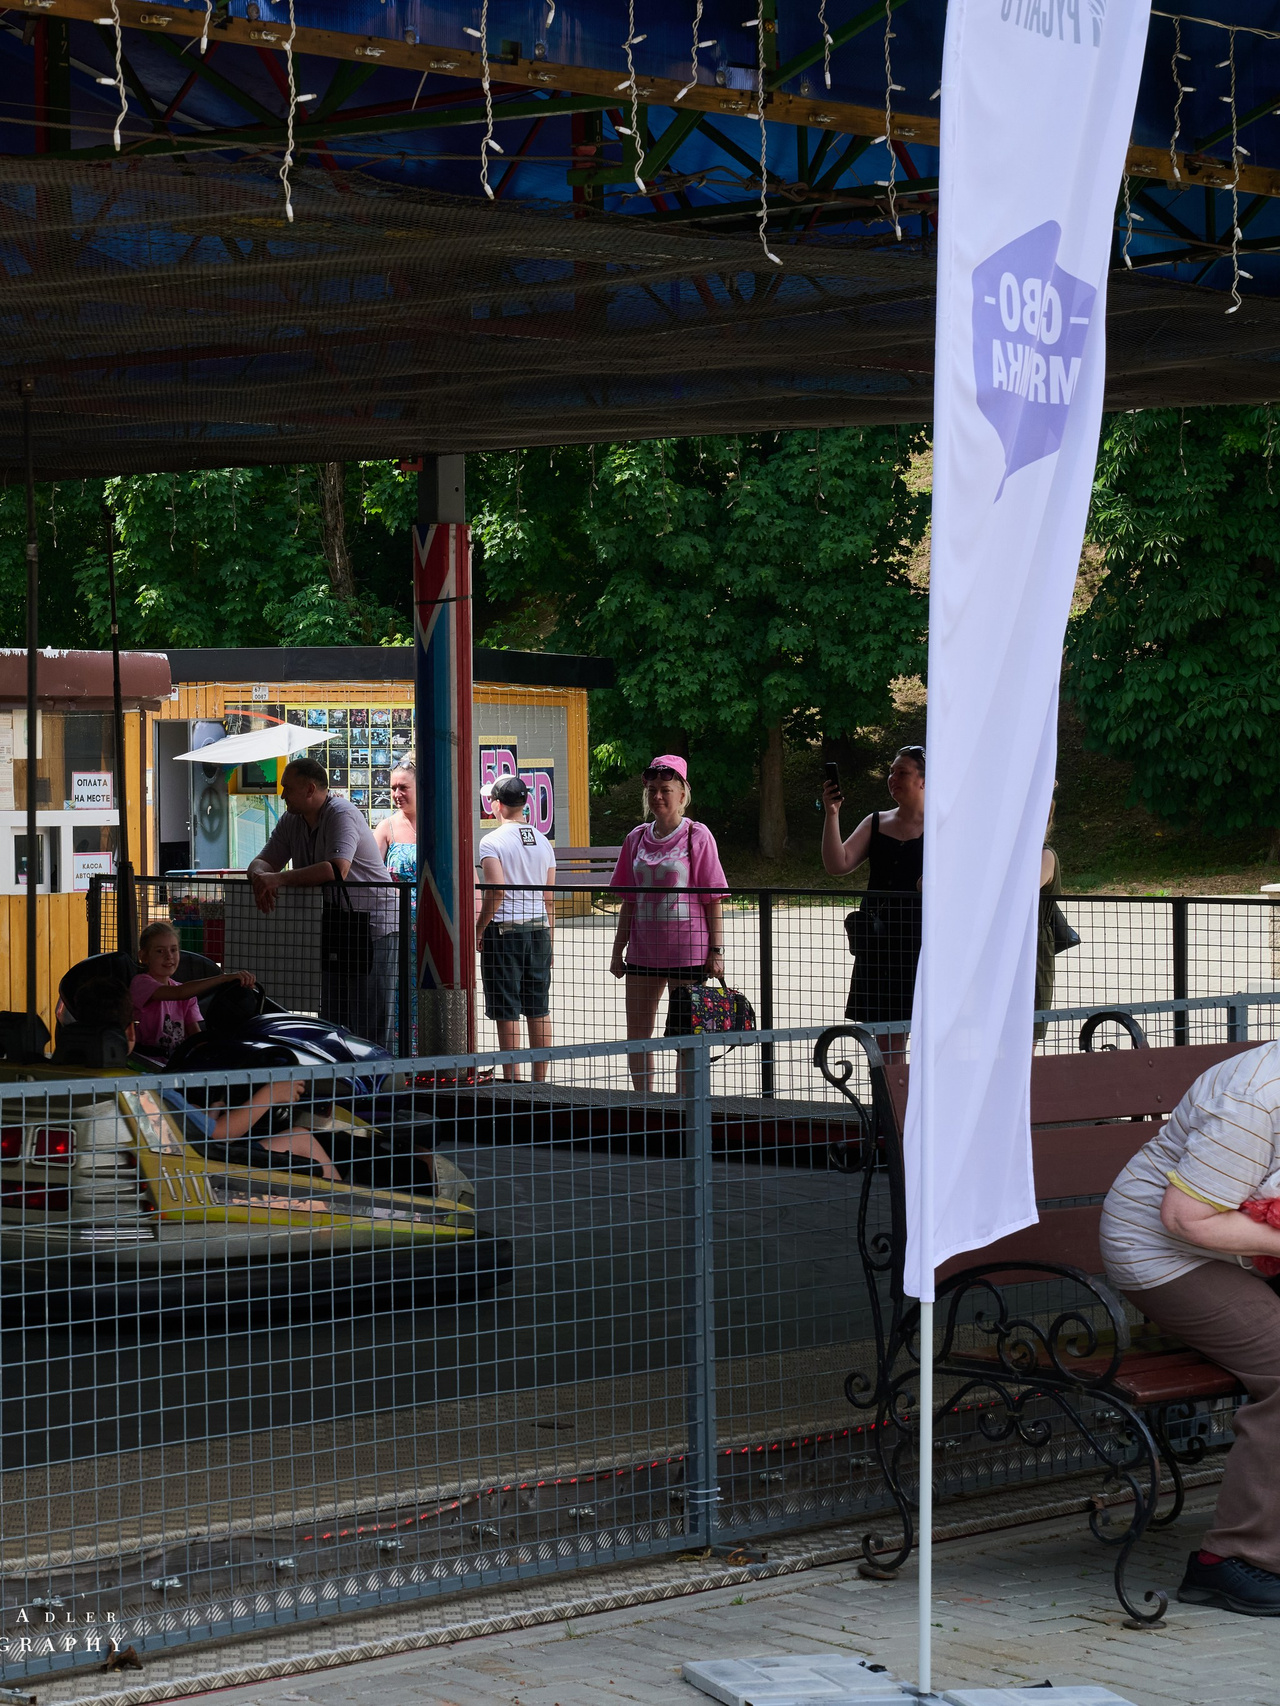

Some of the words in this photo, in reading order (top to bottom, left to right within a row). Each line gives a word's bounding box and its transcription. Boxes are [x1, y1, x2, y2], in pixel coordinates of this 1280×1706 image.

[76, 778, 108, 787] ОПЛАТА
[74, 794, 85, 802] НА
[86, 794, 110, 802] МЕСТЕ
